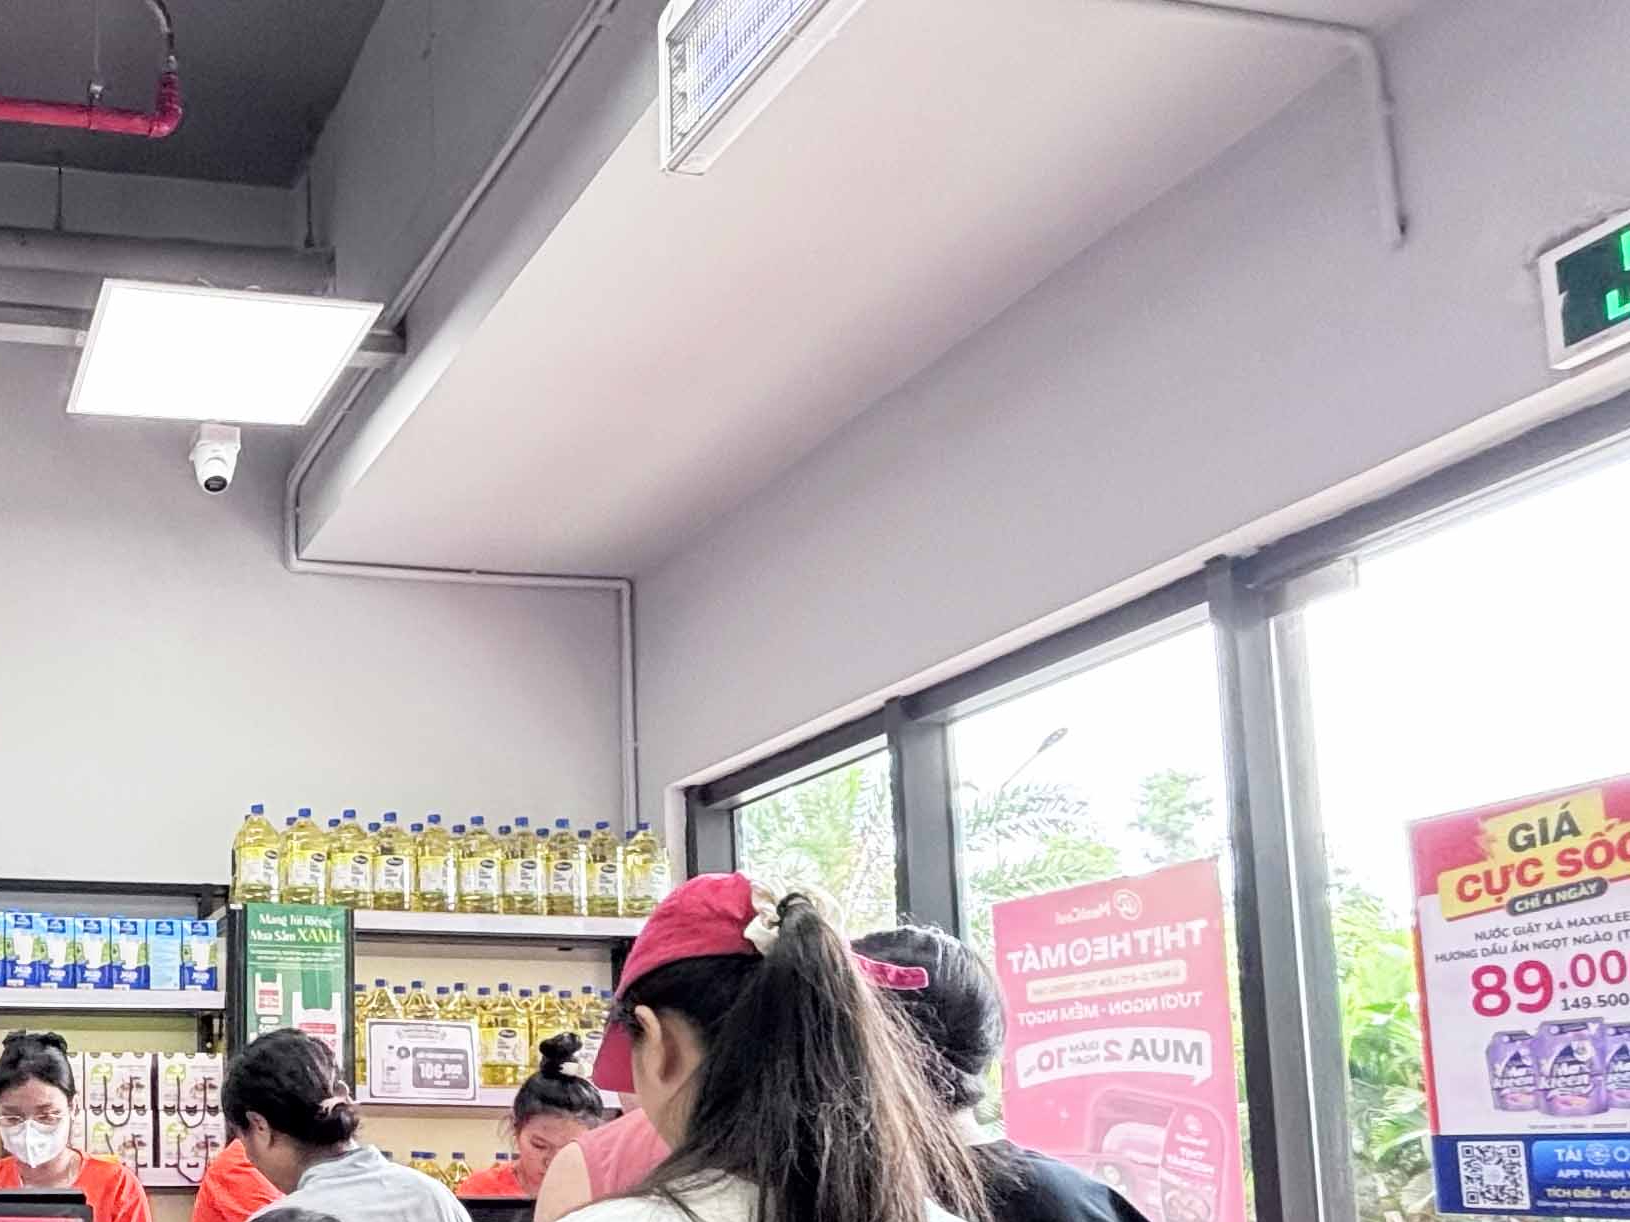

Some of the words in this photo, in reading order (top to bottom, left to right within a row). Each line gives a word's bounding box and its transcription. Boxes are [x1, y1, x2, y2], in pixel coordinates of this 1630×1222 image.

[1507, 801, 1582, 853] GIÁ
[1456, 858, 1544, 904] CỰC
[298, 928, 340, 943] XANH
